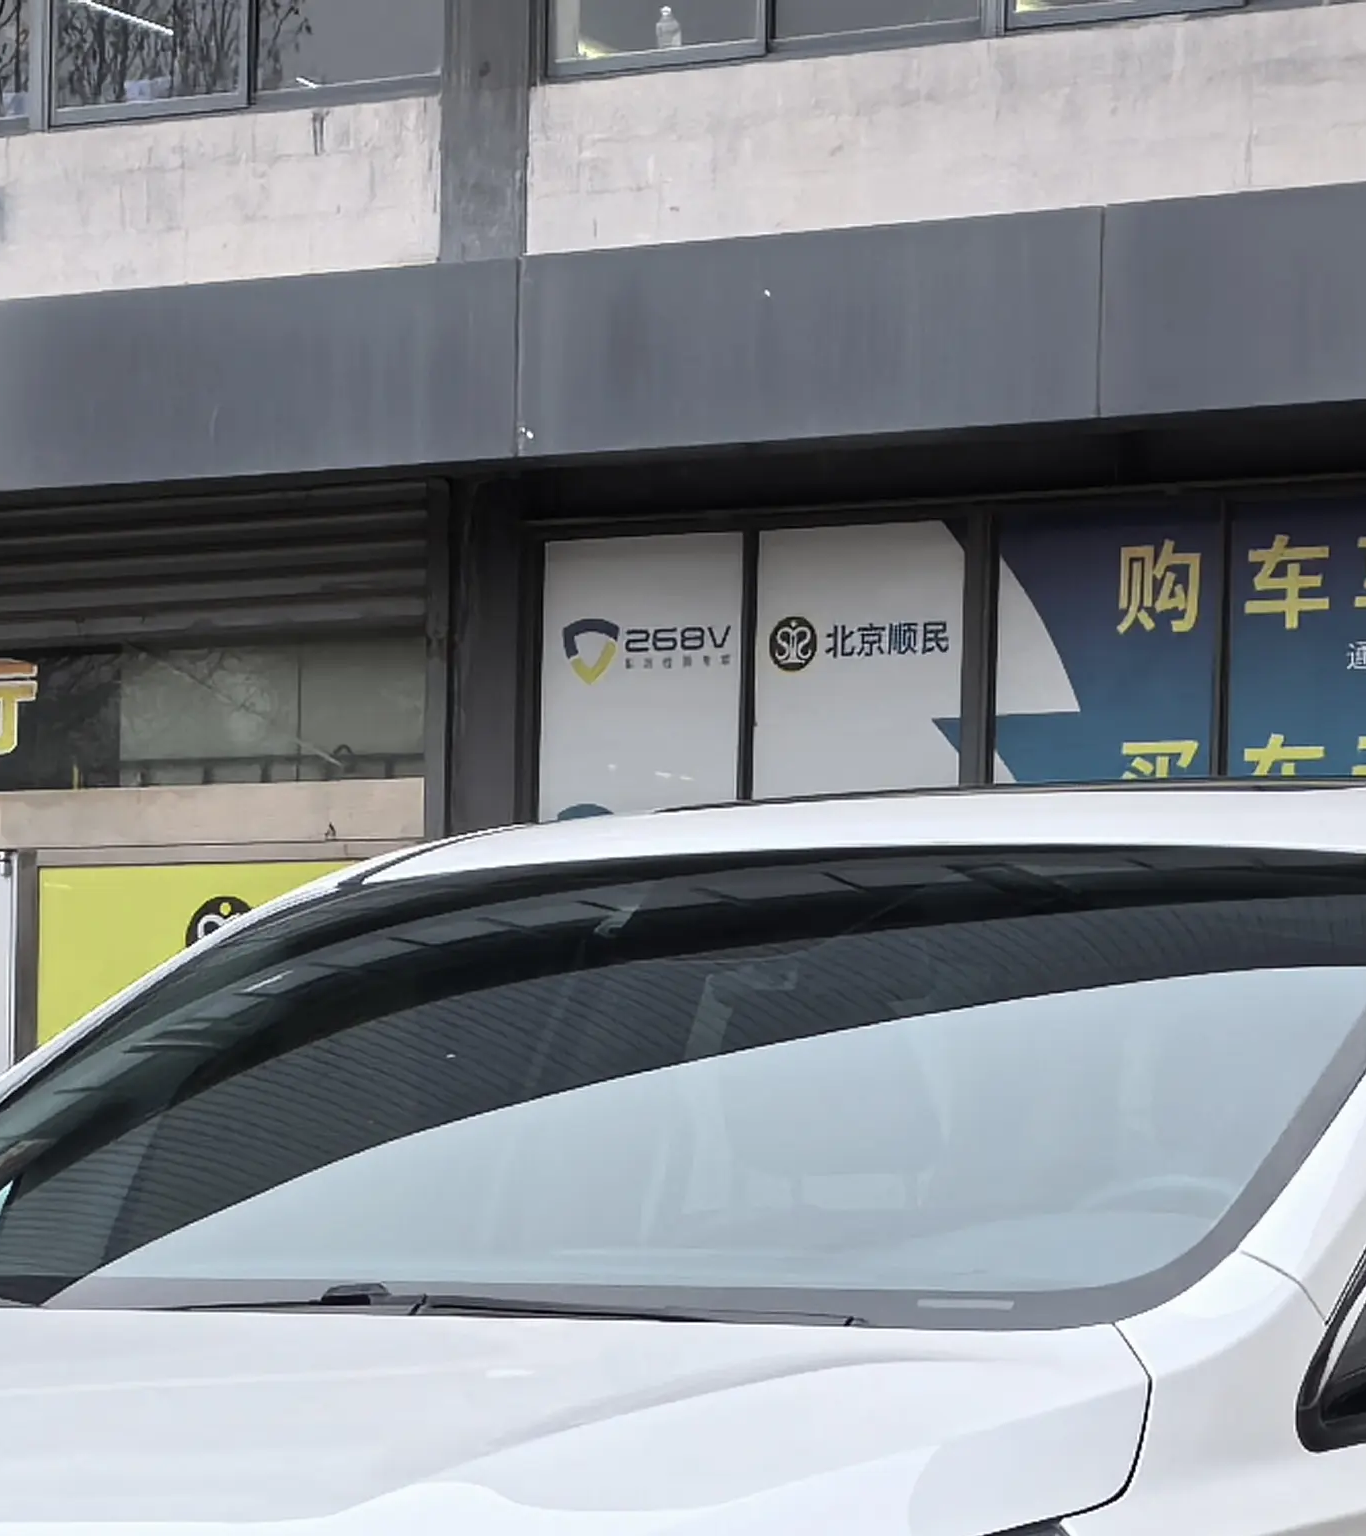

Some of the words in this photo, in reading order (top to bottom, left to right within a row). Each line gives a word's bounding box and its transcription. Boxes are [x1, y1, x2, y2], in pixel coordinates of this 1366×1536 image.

[624, 625, 732, 652] 268V
[825, 621, 950, 659] 北京顺民
